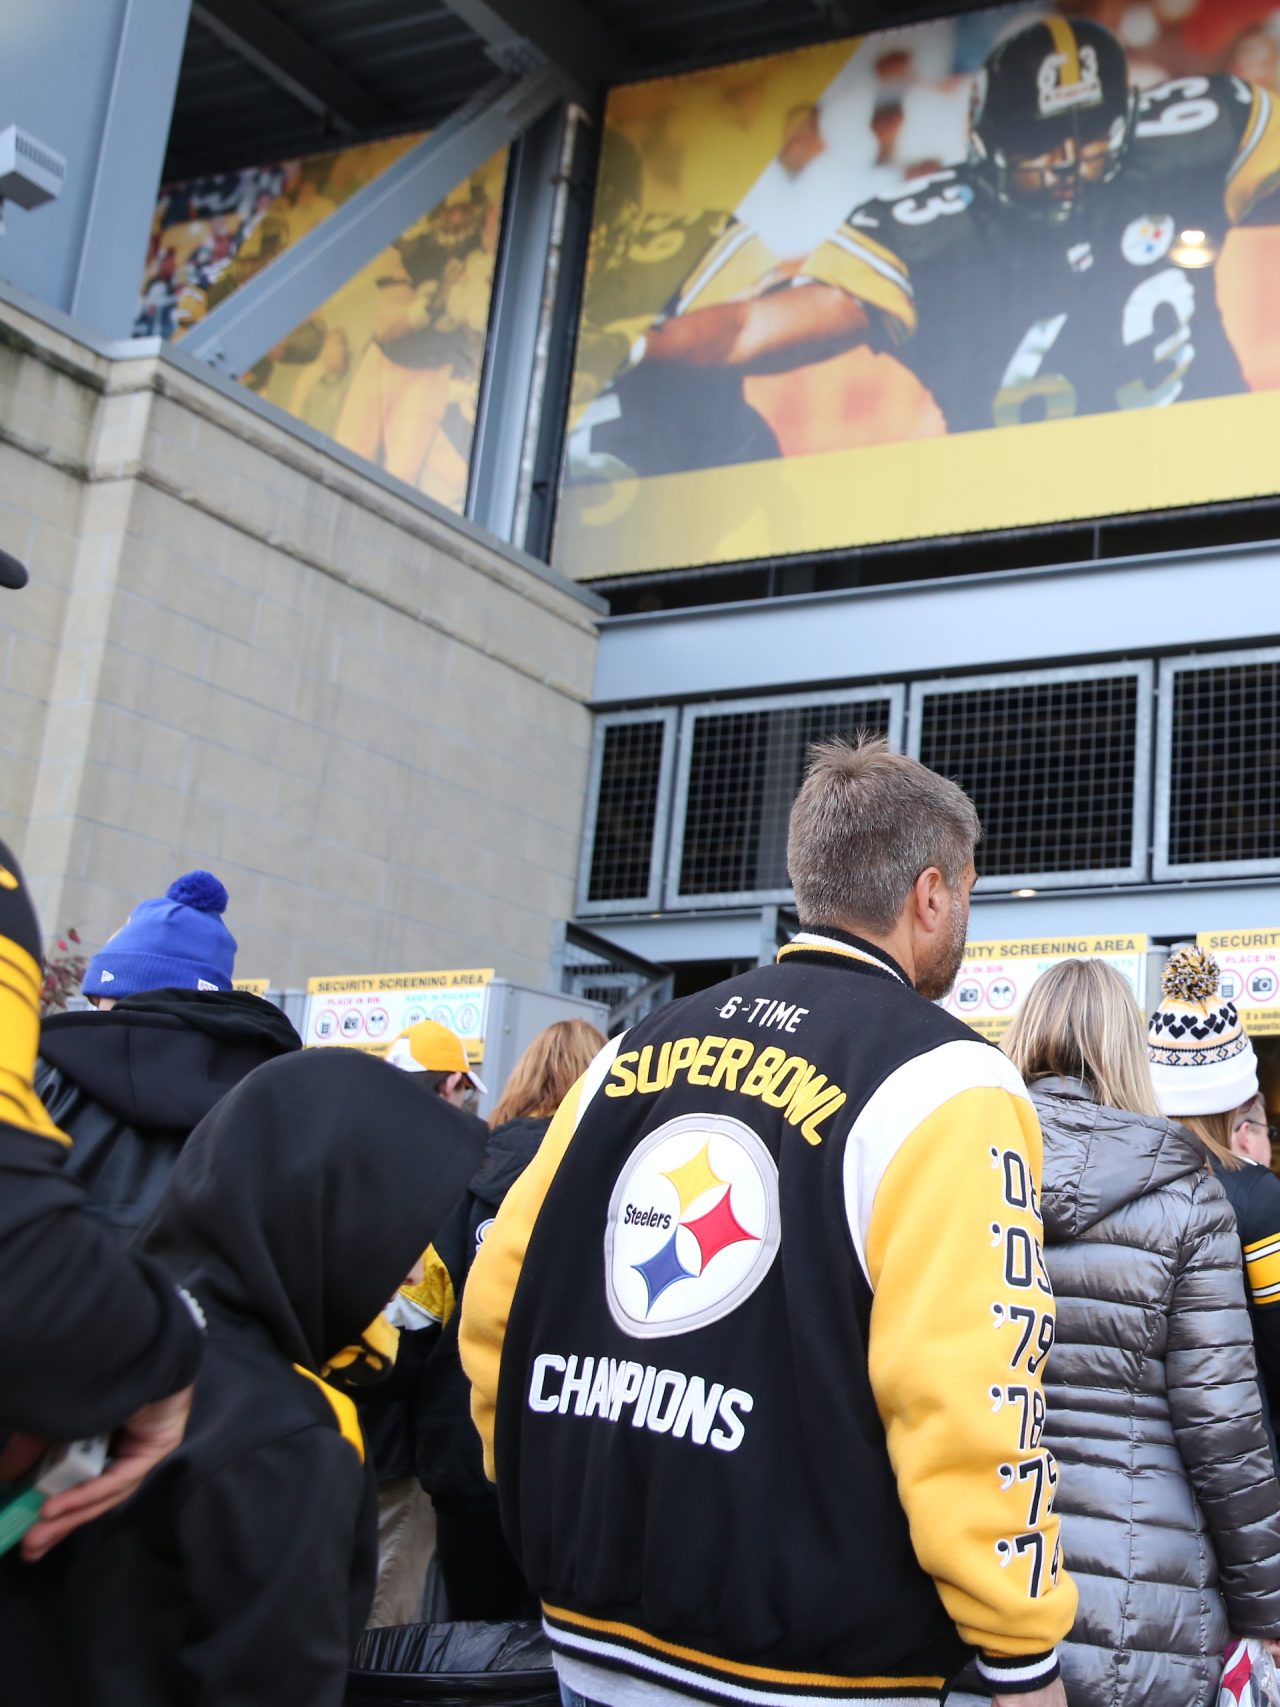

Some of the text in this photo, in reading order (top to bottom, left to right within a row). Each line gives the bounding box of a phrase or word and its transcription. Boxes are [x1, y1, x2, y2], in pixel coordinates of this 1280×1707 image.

[992, 266, 1195, 427] 63
[1000, 942, 1088, 956] SCREENING
[1094, 939, 1136, 952] AREA
[1225, 953, 1261, 964] PLACE
[1265, 952, 1276, 963] IN
[317, 974, 484, 993] SECURITY SCREENING AREA
[717, 996, 809, 1033] 6-TIME
[605, 1035, 847, 1146] SUPER BOWL
[624, 1203, 672, 1230] Steelers
[990, 1301, 1055, 1377] '79
[989, 1384, 1046, 1452] '78
